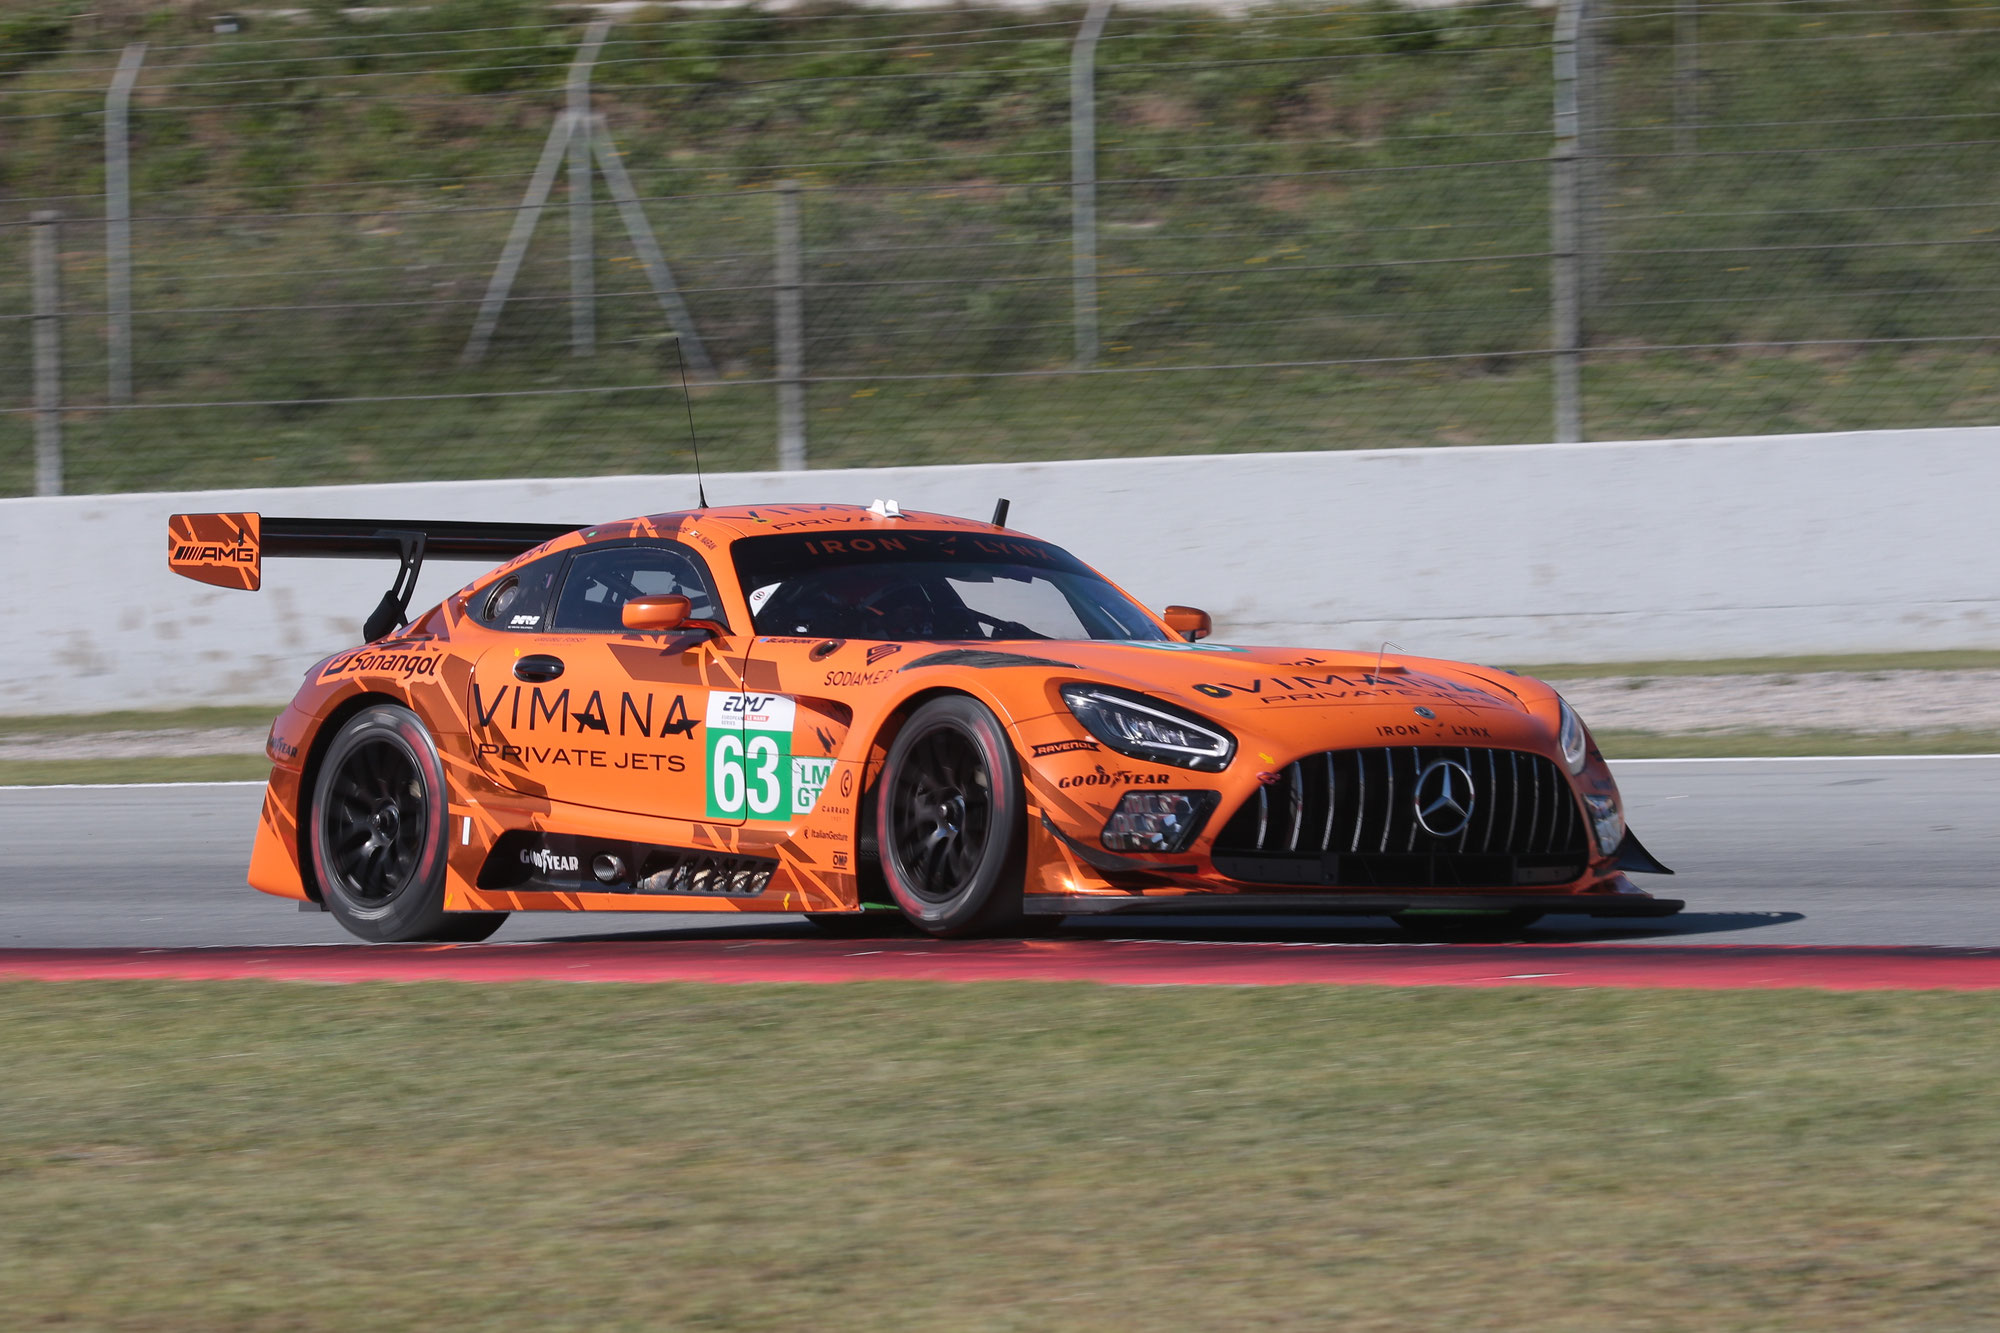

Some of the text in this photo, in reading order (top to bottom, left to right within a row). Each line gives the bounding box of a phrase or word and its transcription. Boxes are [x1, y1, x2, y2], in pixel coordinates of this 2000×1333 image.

[198, 546, 255, 563] AMG
[805, 538, 1056, 561] IRON LYNX
[349, 652, 443, 679] Sonangol
[1220, 673, 1485, 694] VIMANA
[1261, 689, 1421, 705] PRIVATE
[473, 683, 701, 740] VIMANA
[1376, 725, 1492, 738] IRON LYNX
[478, 743, 686, 772] PRIVATE JETS
[1037, 741, 1096, 755] RAVENOL
[713, 734, 781, 814] 63
[801, 764, 831, 785] LM
[832, 854, 848, 867] OMP
